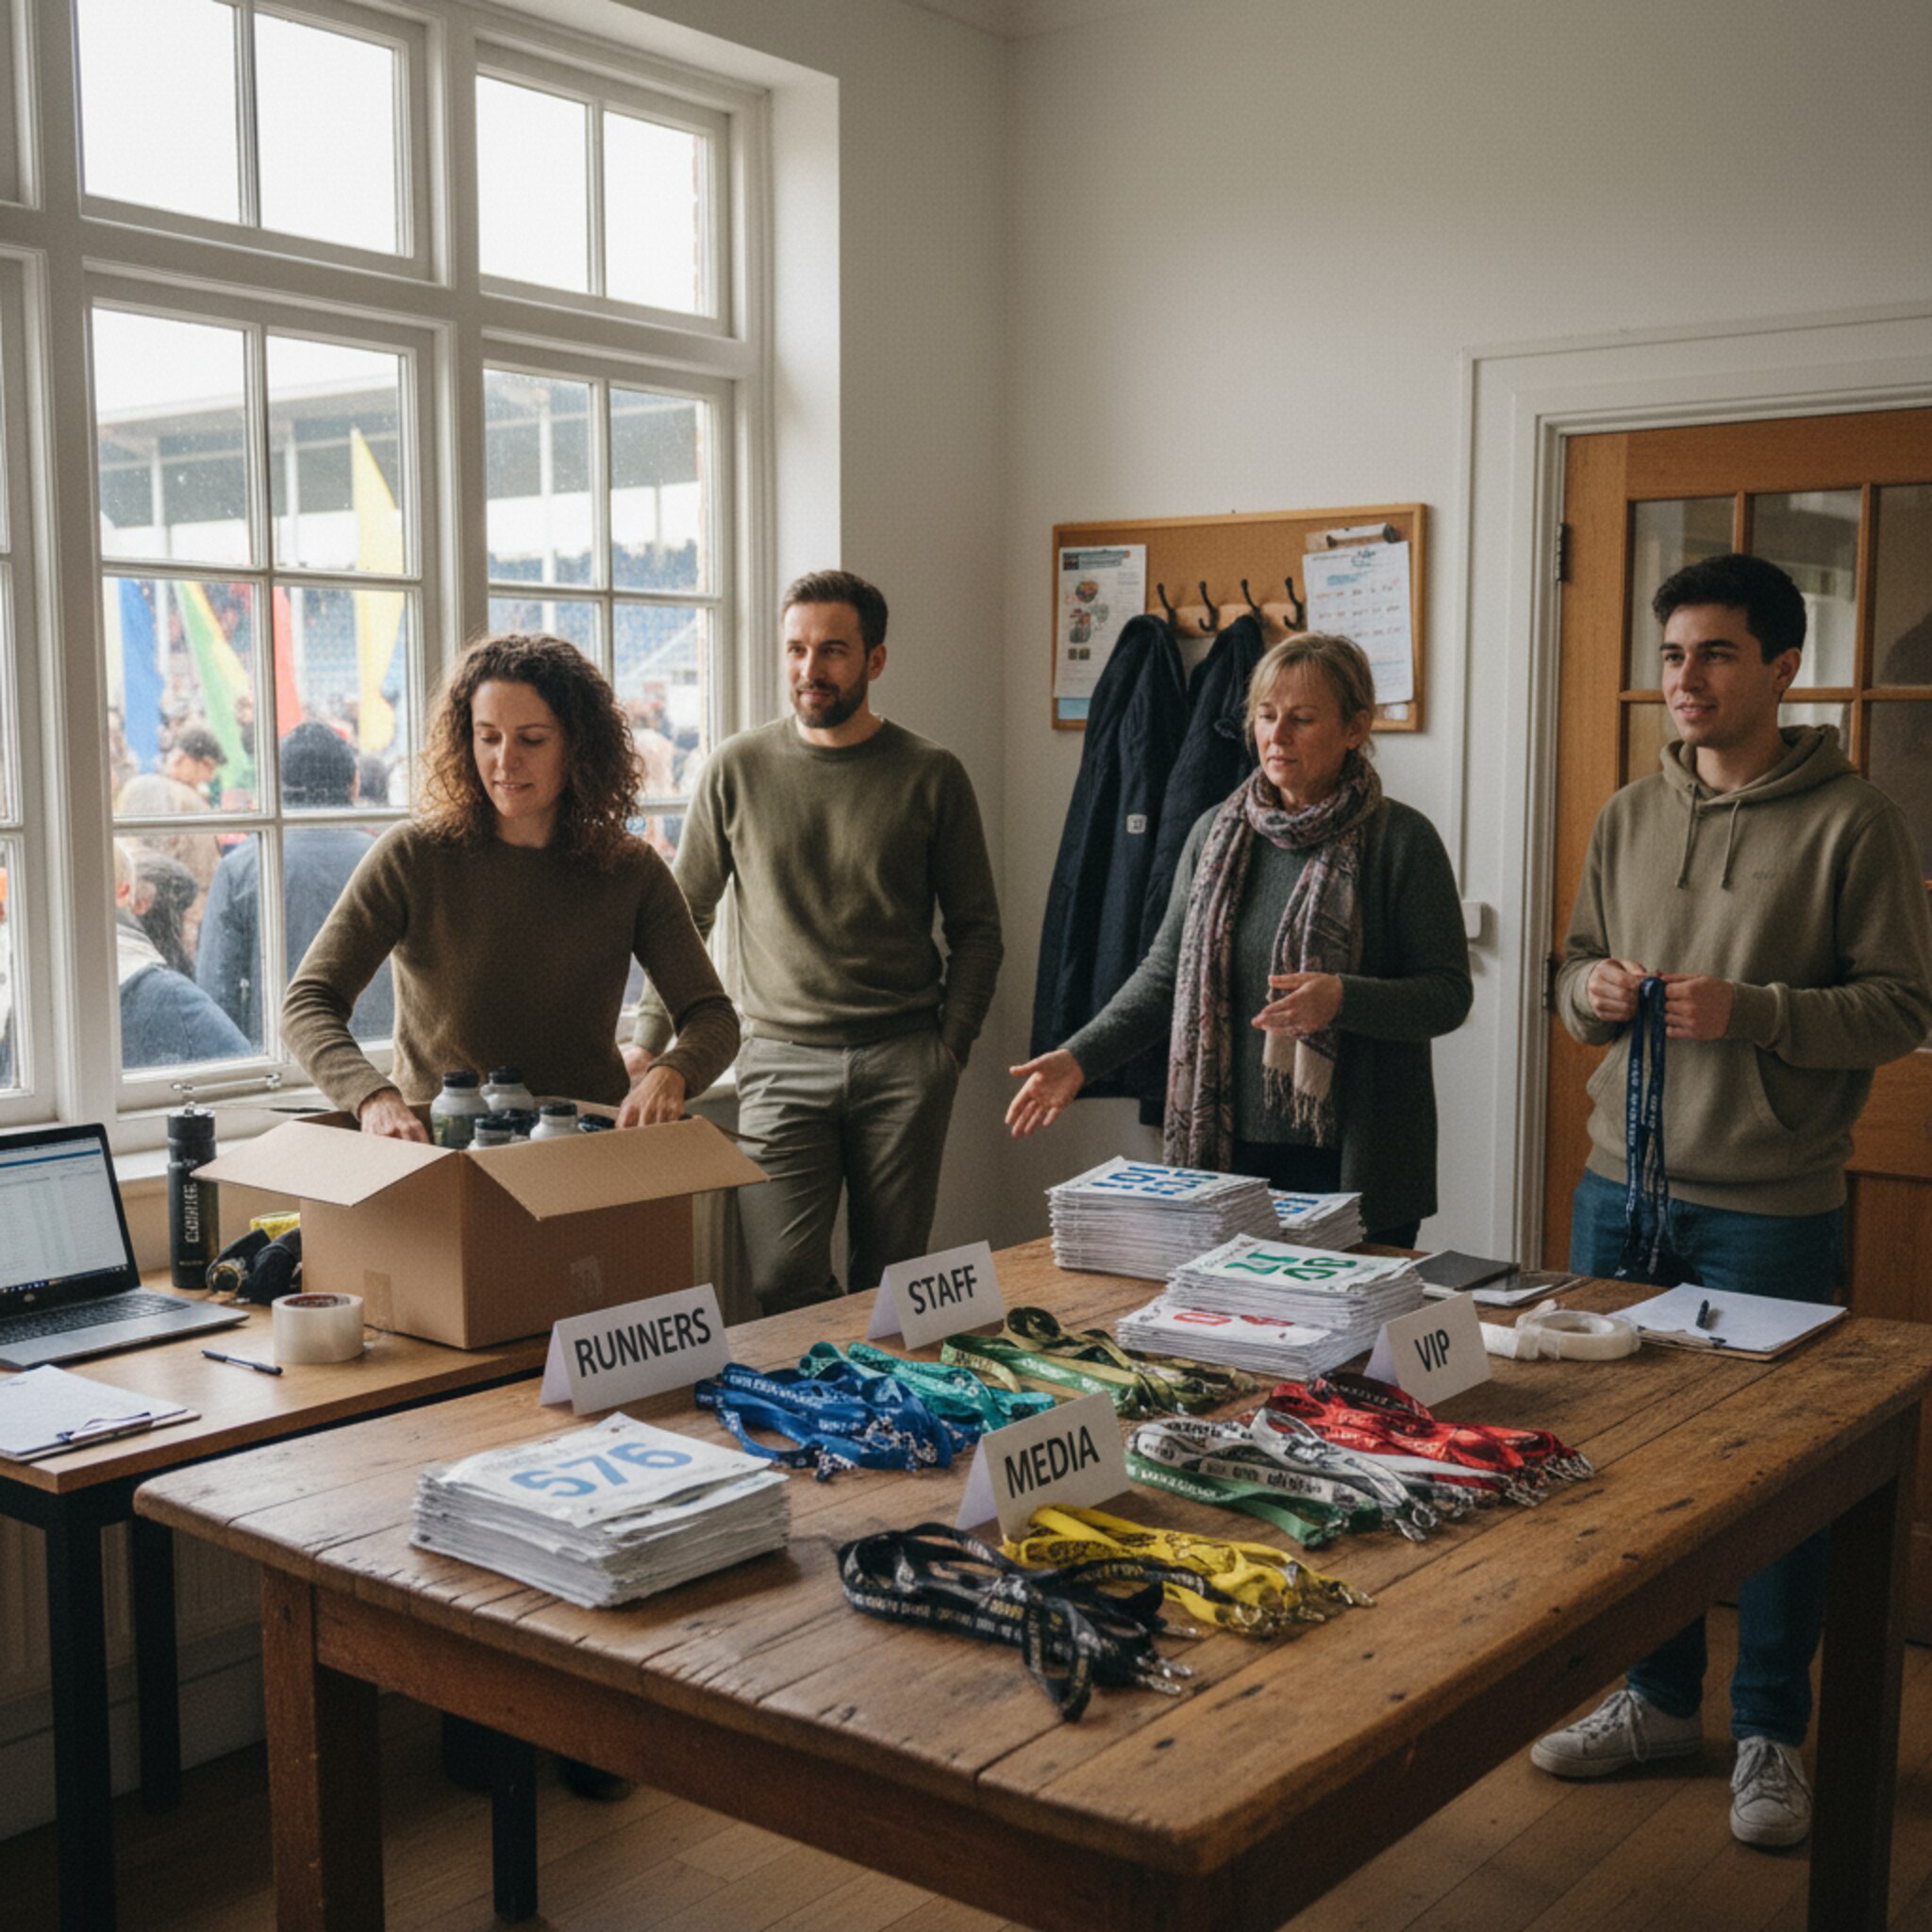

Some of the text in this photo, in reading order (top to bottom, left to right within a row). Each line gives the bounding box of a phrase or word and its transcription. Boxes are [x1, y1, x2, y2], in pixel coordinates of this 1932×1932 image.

[908, 1264, 977, 1315] STAFF
[574, 1307, 712, 1377] RUNNERS
[1414, 1328, 1450, 1373] VIP
[509, 1441, 693, 1497] 576
[1005, 1425, 1100, 1499] MEDIA
